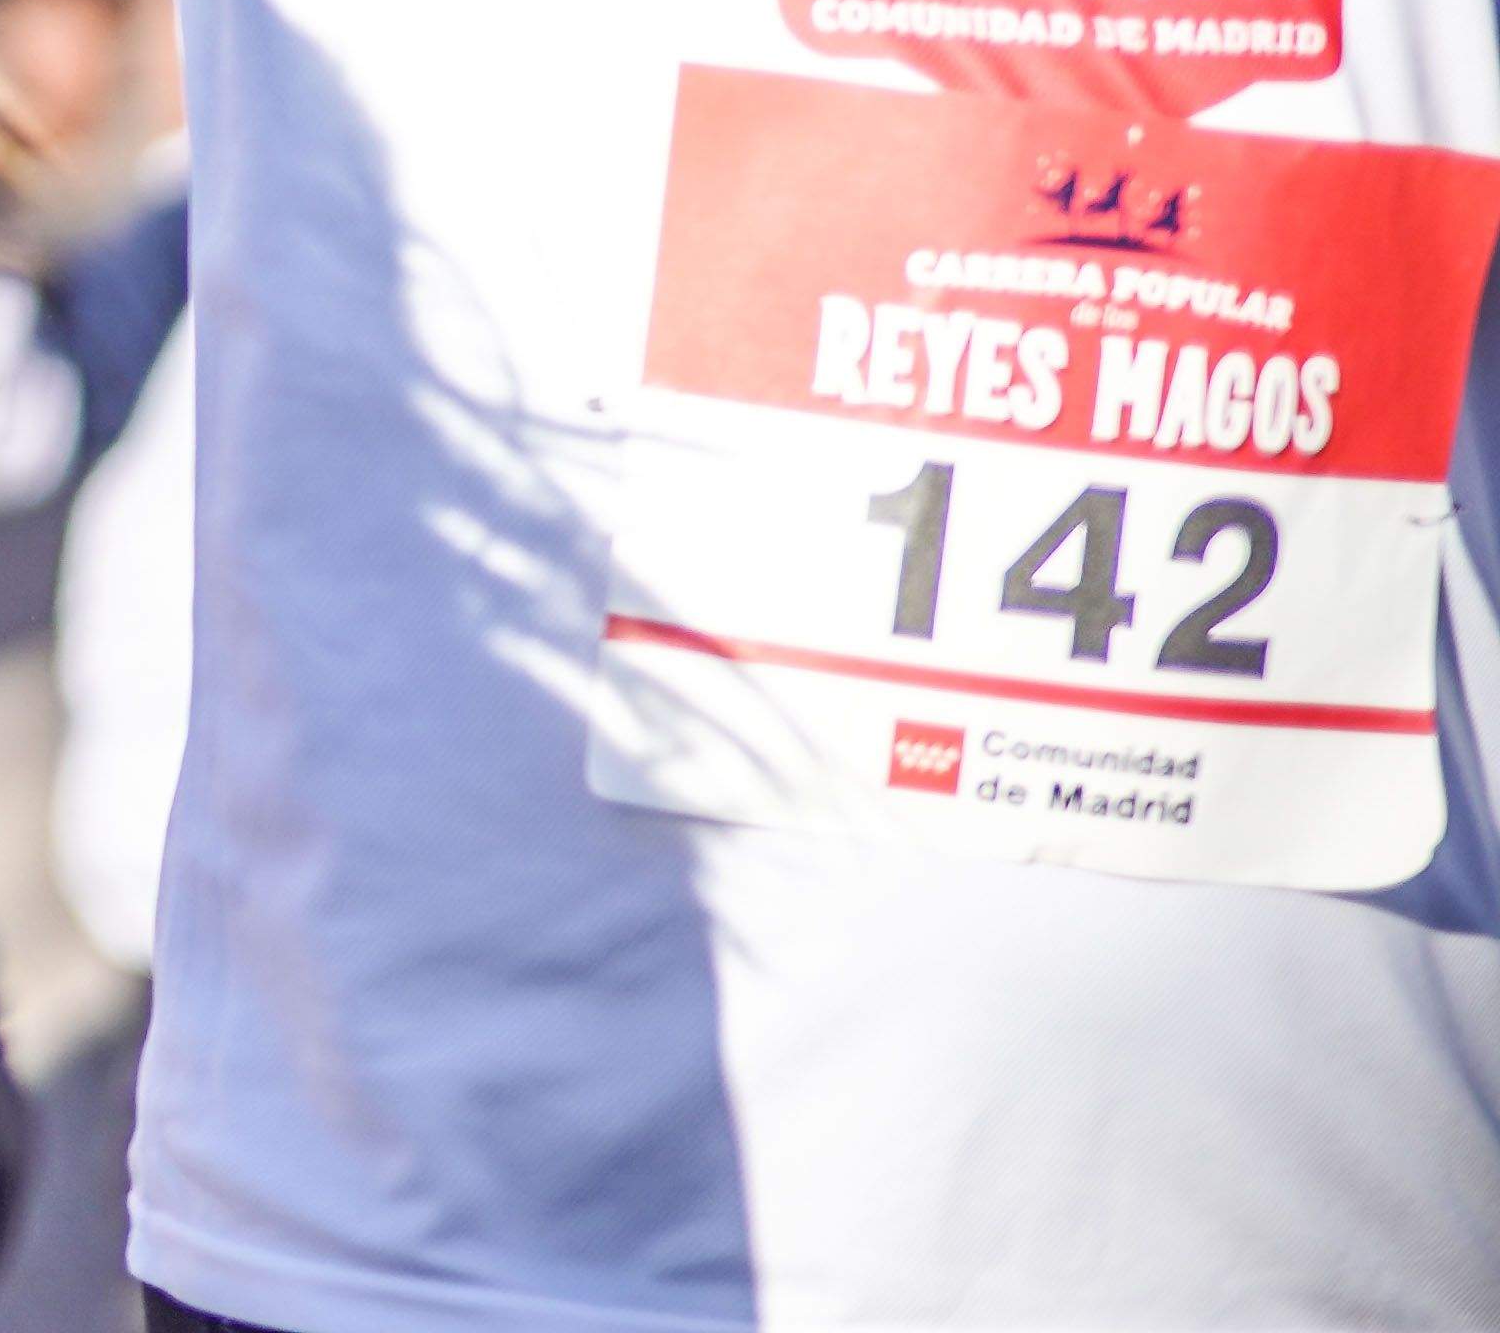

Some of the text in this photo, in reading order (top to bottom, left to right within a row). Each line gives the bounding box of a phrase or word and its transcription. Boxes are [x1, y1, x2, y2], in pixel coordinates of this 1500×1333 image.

[1093, 15, 1147, 52] DE
[1153, 18, 1328, 55] MADRID
[904, 249, 1295, 332] CARRERA POPULAR
[812, 293, 1340, 456] REYES MAGOS
[867, 459, 1279, 680] 142
[981, 730, 1203, 780] Comunidad
[976, 777, 1197, 825] de Madrid
